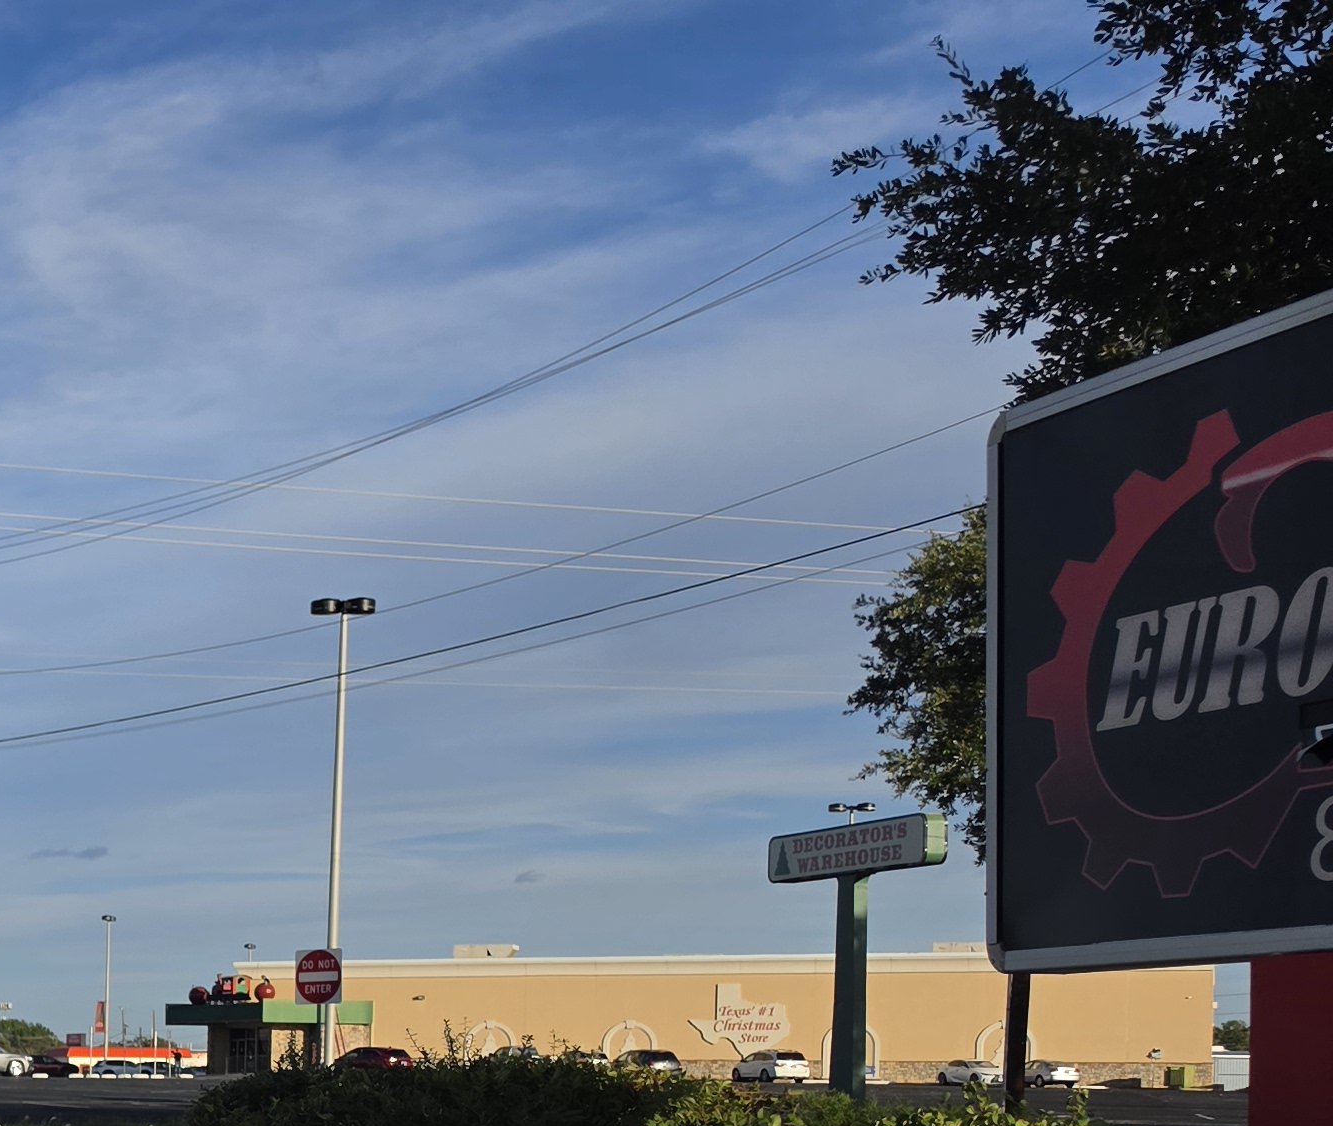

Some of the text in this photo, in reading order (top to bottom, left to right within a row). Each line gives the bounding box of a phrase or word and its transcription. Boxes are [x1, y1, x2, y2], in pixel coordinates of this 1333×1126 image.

[1096, 565, 1333, 732] EURO
[792, 822, 908, 854] DECORATOR'S
[797, 844, 902, 874] WAREHOUSE
[302, 959, 335, 970] DO NOT
[304, 984, 332, 994] ENTER
[713, 1018, 781, 1033] Christmas
[738, 1033, 769, 1044] Store
